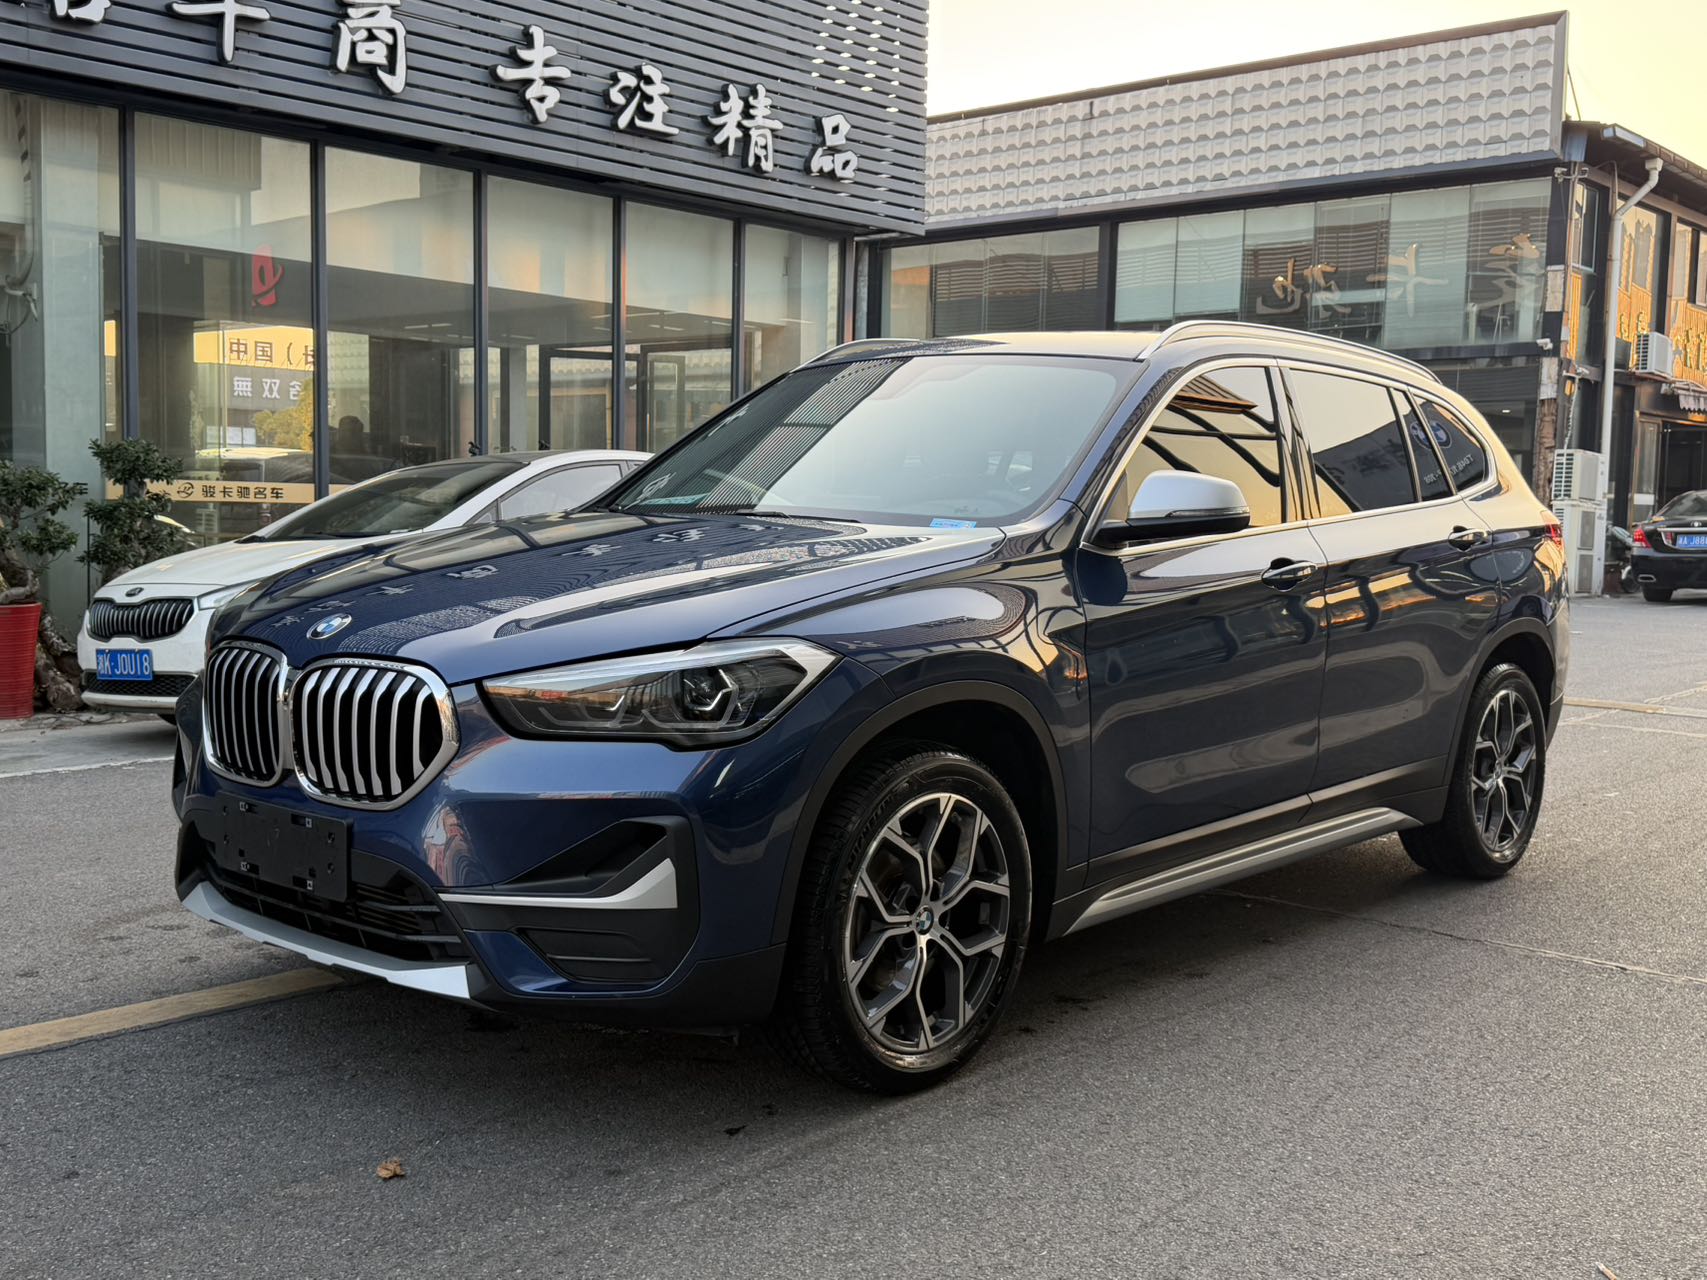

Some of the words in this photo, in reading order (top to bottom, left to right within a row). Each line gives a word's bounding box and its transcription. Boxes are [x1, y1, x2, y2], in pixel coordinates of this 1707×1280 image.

[202, 485, 284, 499] 骏卡驰名车
